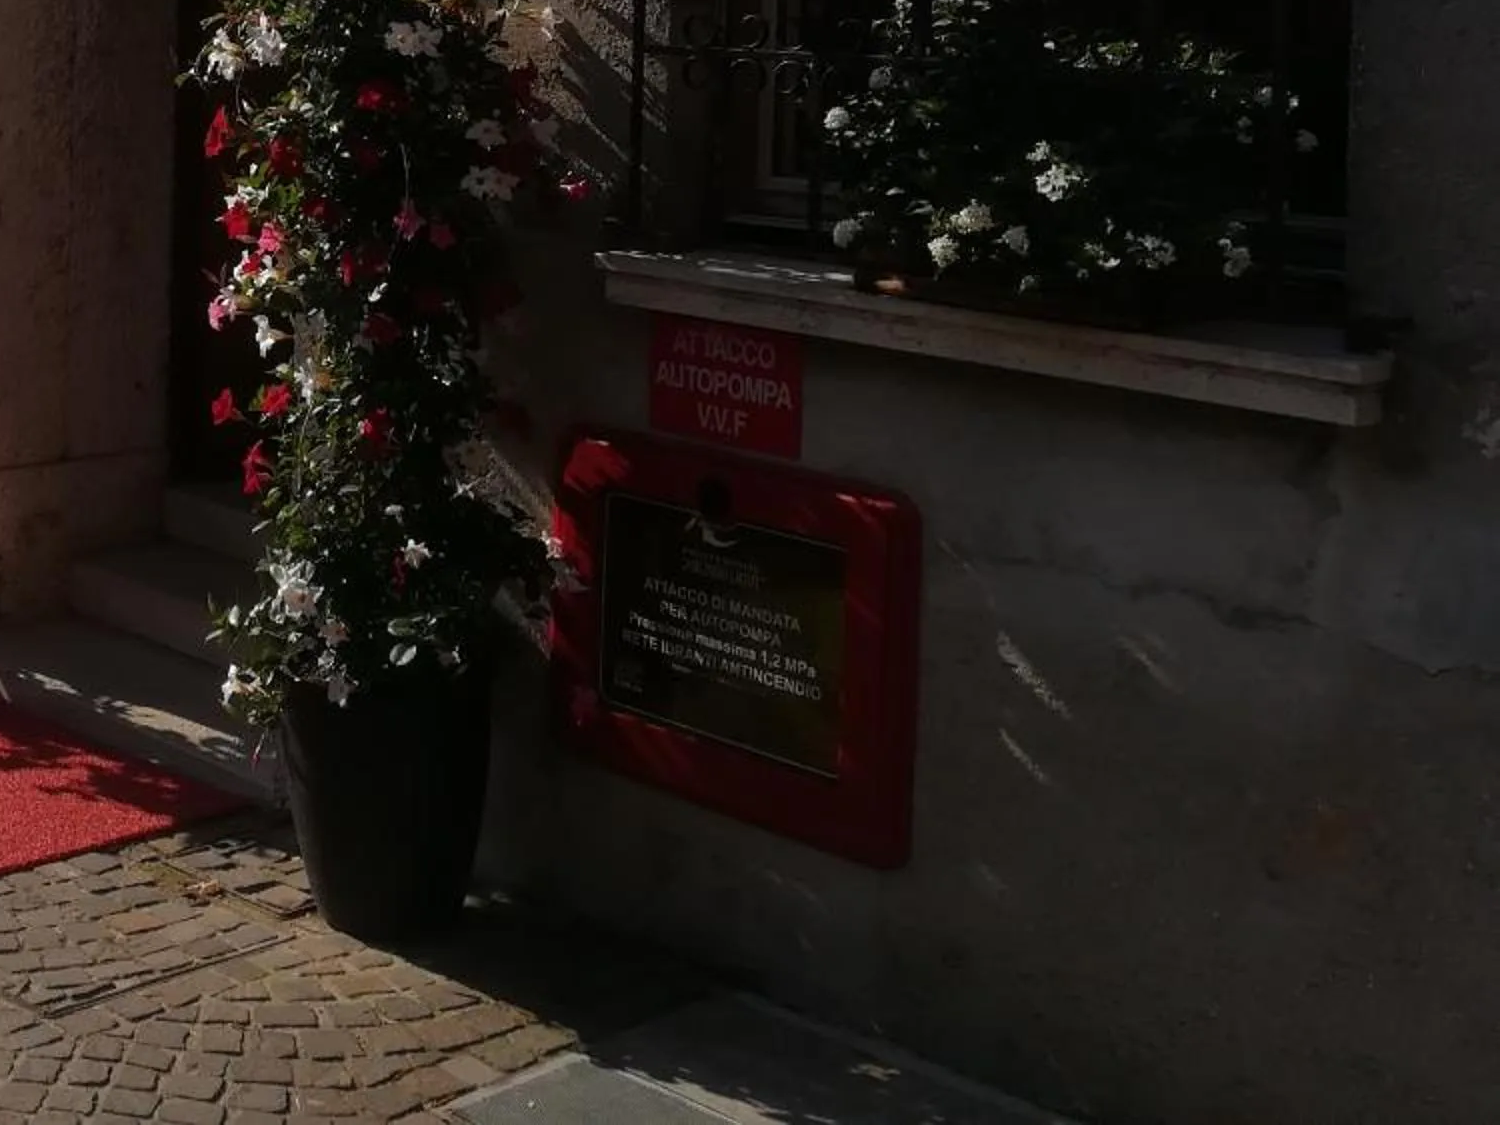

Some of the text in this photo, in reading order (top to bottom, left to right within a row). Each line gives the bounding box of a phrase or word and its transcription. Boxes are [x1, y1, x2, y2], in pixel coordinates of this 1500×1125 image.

[672, 329, 776, 369] ATTACCO
[656, 359, 793, 411] AUTOPOMPA
[644, 576, 802, 636] ATTACCO DI MANDATA
[690, 609, 782, 649] AUTOPOMPA
[720, 658, 822, 701] ANTINCENDIO
[784, 655, 817, 679] MPa
